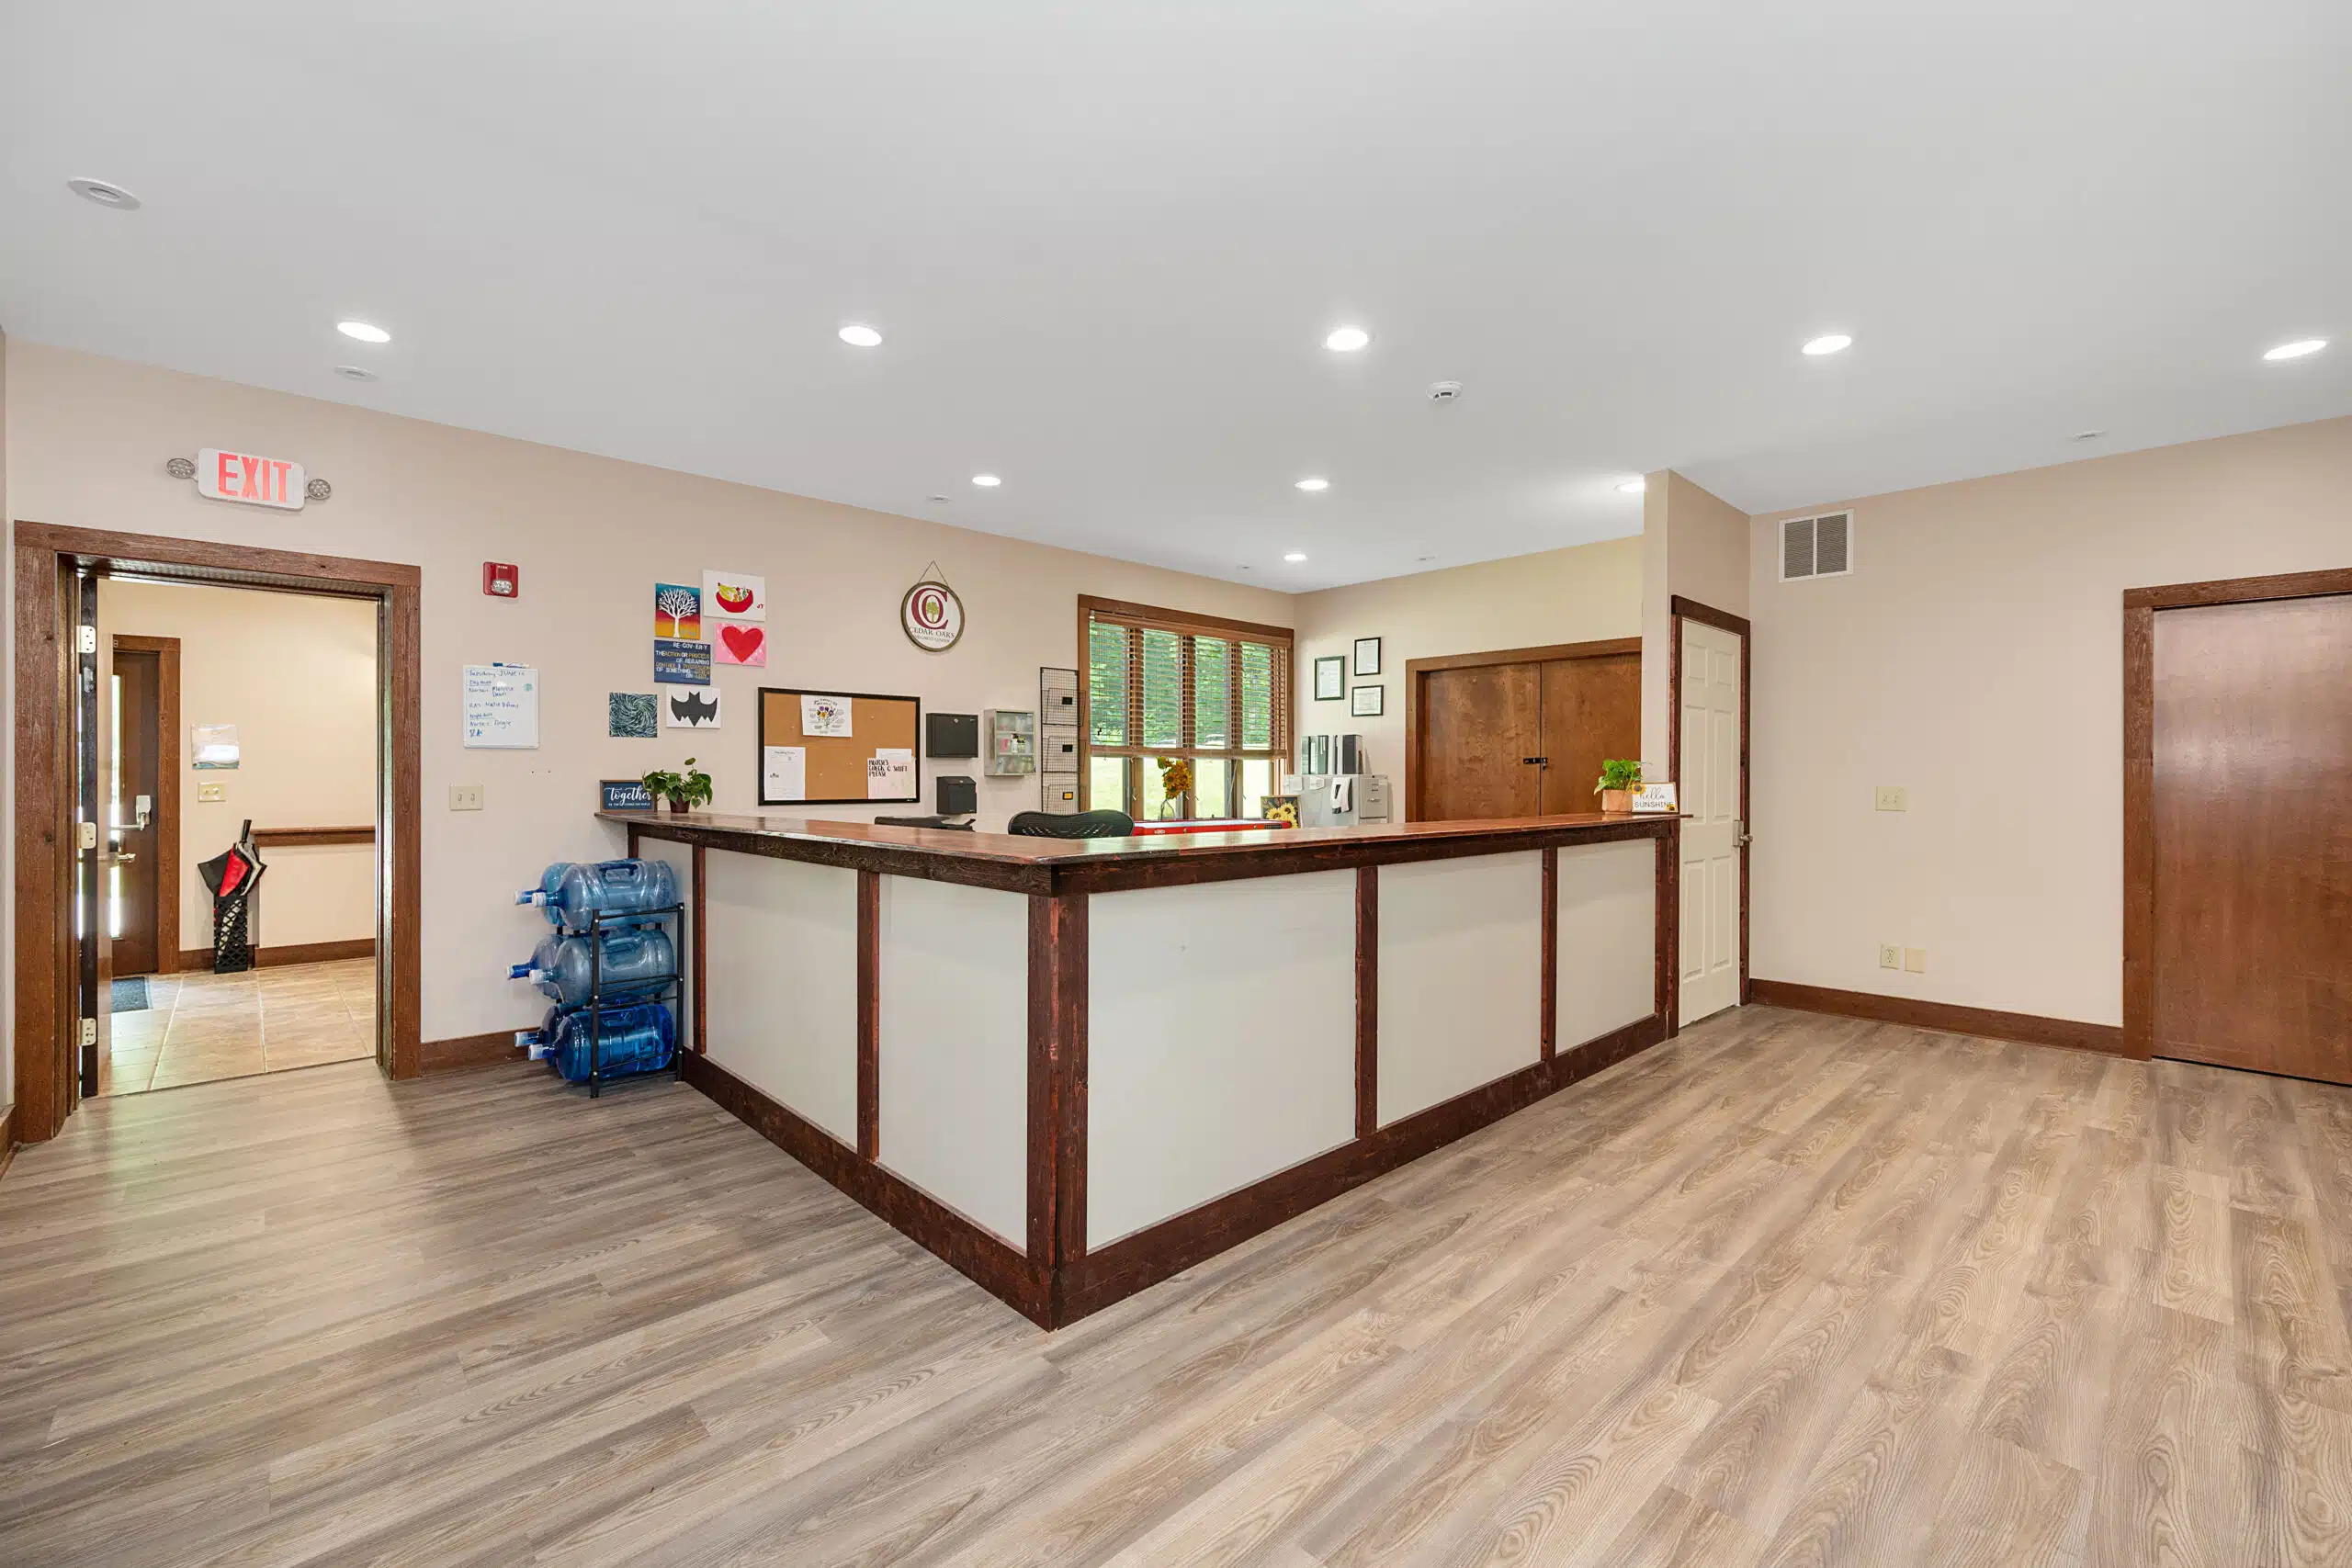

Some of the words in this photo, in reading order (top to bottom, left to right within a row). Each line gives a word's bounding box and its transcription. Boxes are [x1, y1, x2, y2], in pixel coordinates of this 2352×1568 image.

[218, 452, 292, 503] EXIT
[910, 626, 934, 636] CEDAR
[604, 784, 651, 807] together
